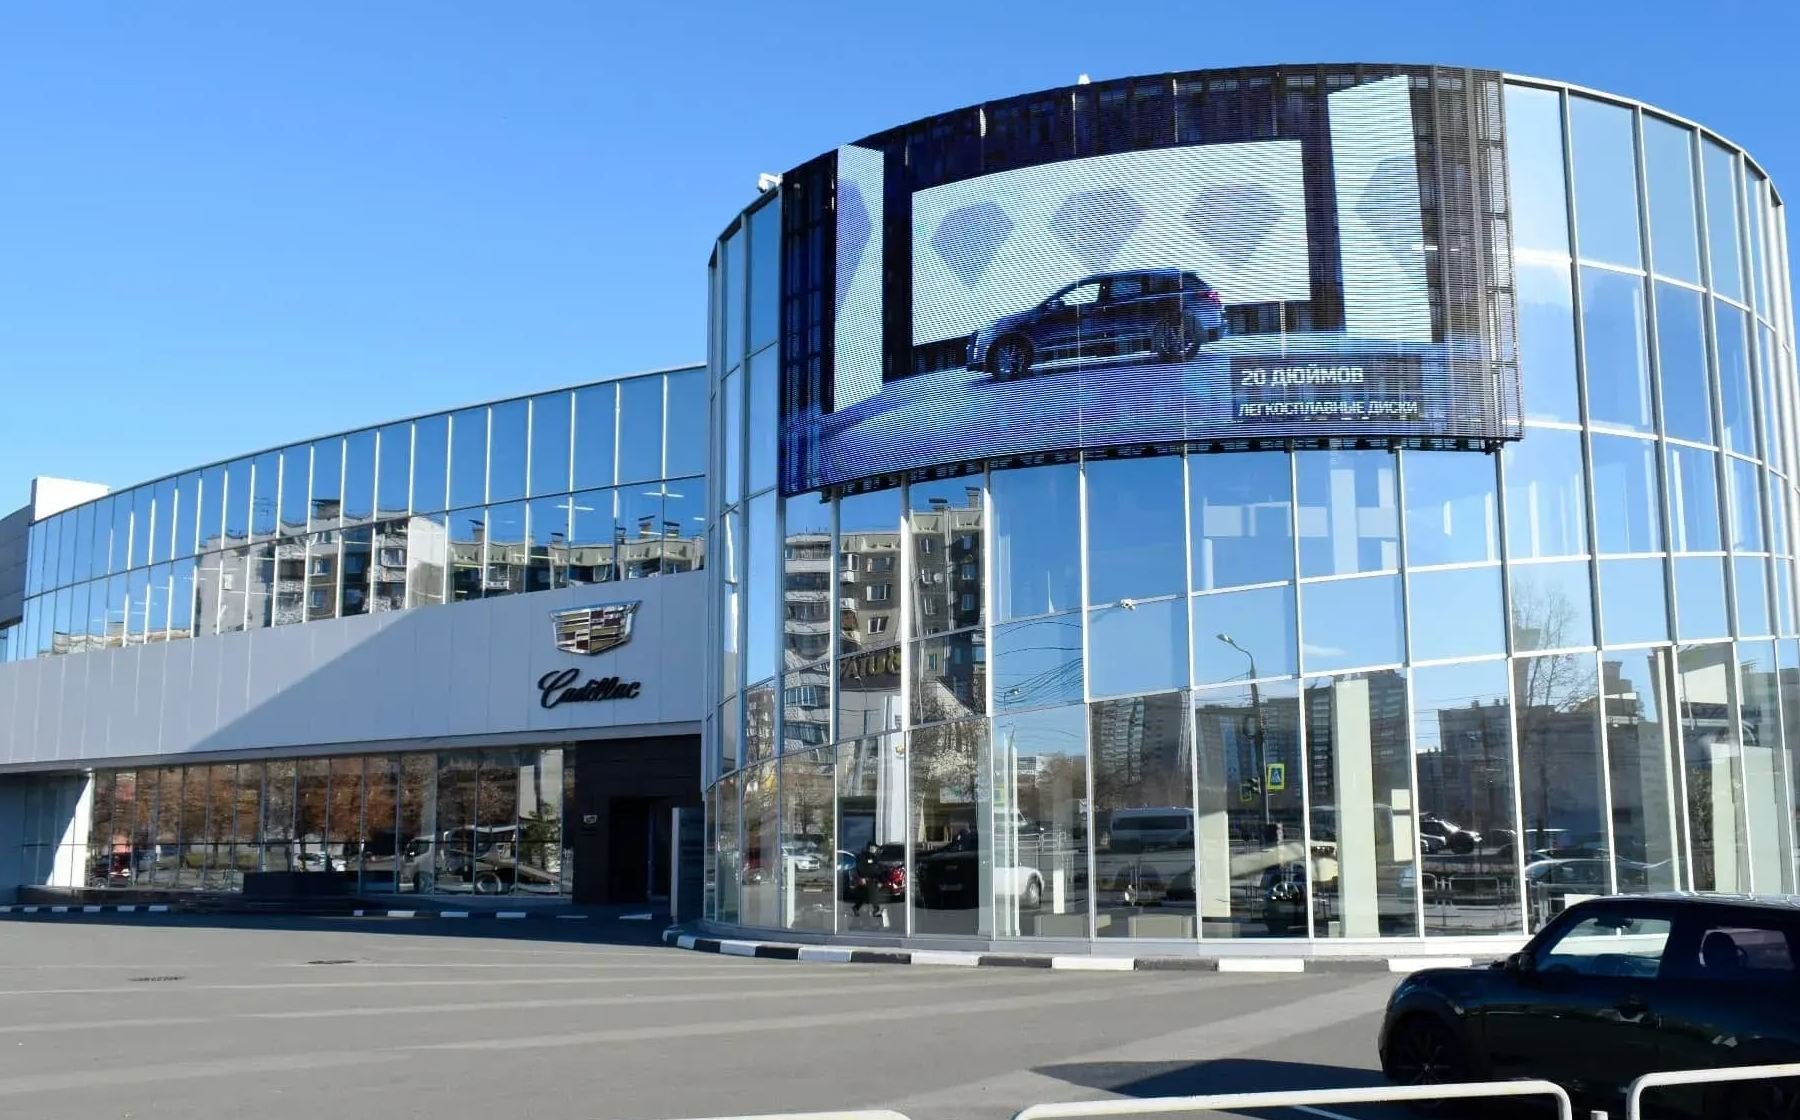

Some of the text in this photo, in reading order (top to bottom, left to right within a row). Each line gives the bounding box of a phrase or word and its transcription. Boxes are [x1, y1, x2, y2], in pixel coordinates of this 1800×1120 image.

[1241, 364, 1364, 387] 20 ДЮЙМОВ
[1238, 400, 1418, 417] ЛЕГКОСПЛАВНЫЕ ДИСКИ
[537, 667, 642, 709] Cadillac
